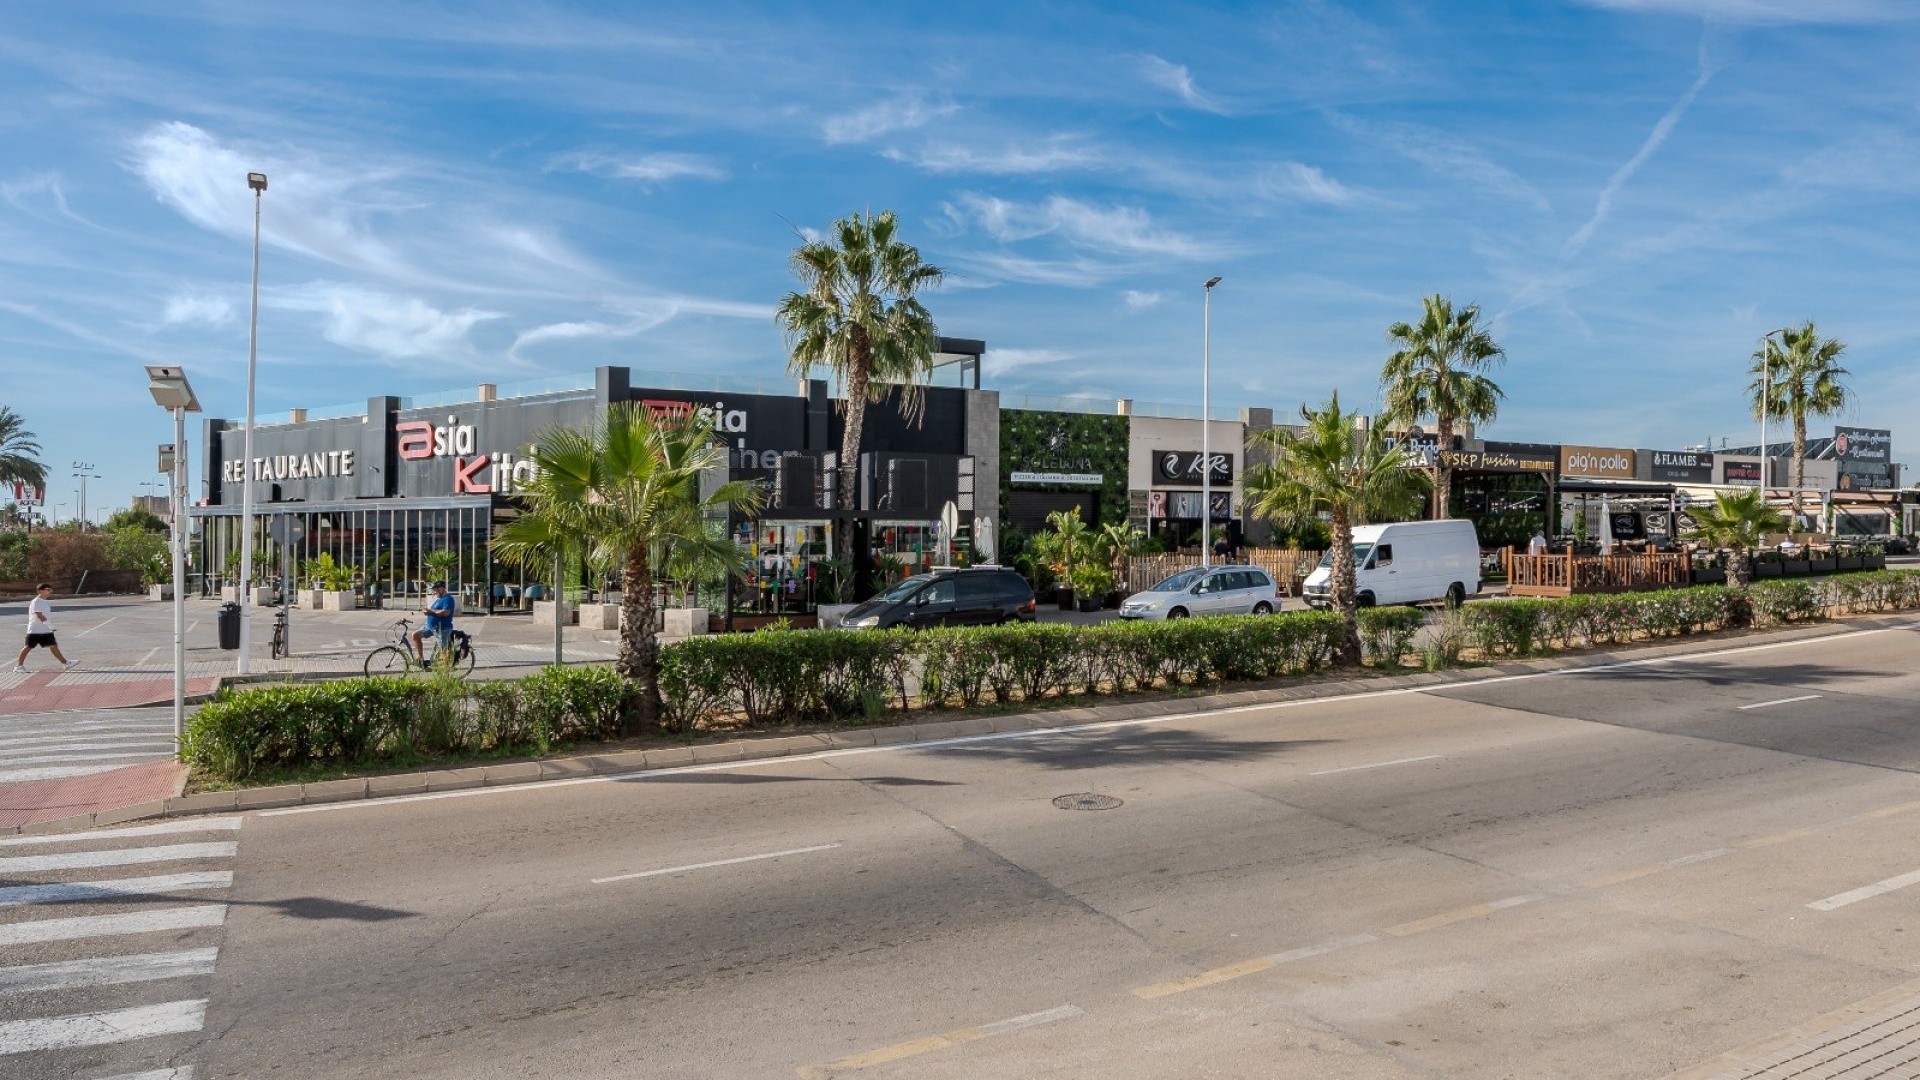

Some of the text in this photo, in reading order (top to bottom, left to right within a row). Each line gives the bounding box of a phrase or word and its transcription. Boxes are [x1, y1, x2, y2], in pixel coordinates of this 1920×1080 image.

[1410, 438, 1441, 460] Bridg
[1662, 453, 1698, 467] FLAMES
[224, 450, 353, 482] RETAURANTE
[455, 444, 555, 493] Kitc
[1452, 453, 1478, 468] SKP
[1480, 453, 1518, 469] fusión
[1568, 451, 1628, 473] pig'n pollo
